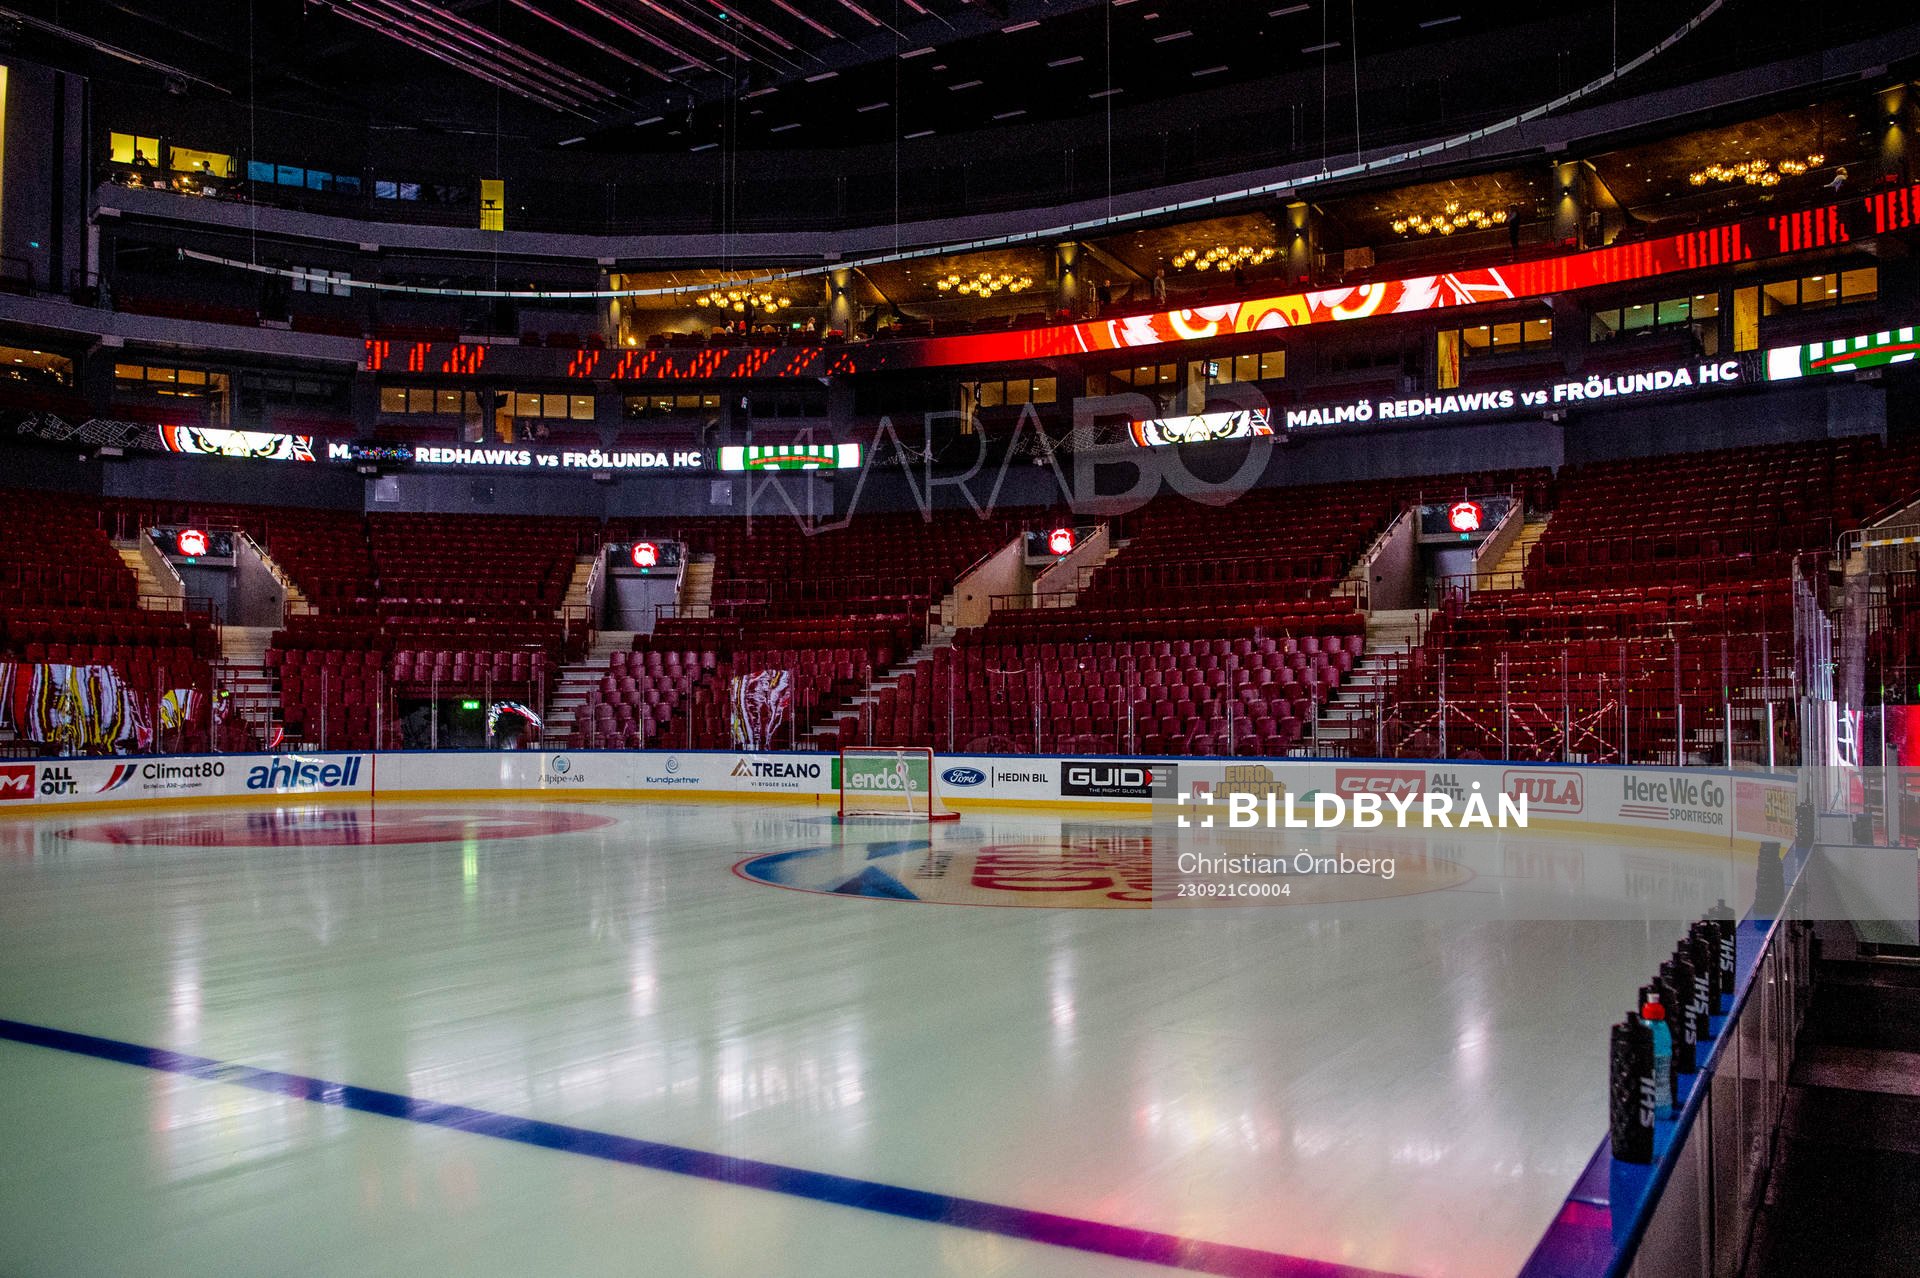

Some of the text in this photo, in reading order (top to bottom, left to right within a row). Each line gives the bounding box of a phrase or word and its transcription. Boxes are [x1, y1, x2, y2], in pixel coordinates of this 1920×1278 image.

[1287, 361, 1739, 428] MALMÖ REDHAWKS vs FRÖLUNDA HC
[415, 447, 531, 465] REDHAWKS
[536, 454, 558, 466] vs
[563, 450, 669, 467] FRÖLUNDA
[673, 452, 702, 467] HC
[41, 768, 72, 780] ALL
[143, 762, 225, 779] Climat80
[247, 756, 361, 788] ahlsell
[752, 763, 821, 779] TREANO
[844, 767, 917, 790] Lendo.e
[949, 769, 977, 784] Ford
[998, 773, 1048, 783] HEDIN BIL
[1068, 768, 1167, 787] GUIDE
[1225, 765, 1267, 782] EURO
[41, 781, 79, 795] OUT.
[646, 776, 700, 785] Kundpartner
[1340, 776, 1421, 793] CCM
[1431, 774, 1459, 786] ALL
[1213, 781, 1282, 799] JACKPOT
[1509, 777, 1579, 806] JULA
[1623, 775, 1667, 802] Here
[1670, 778, 1698, 804] We
[1700, 779, 1724, 808] Go
[1669, 808, 1723, 825] SPORTRESOR
[1720, 935, 1734, 973] SHL
[1695, 972, 1709, 1015] SHL
[1685, 1002, 1697, 1045] SHL
[1639, 1070, 1656, 1128] SHL
